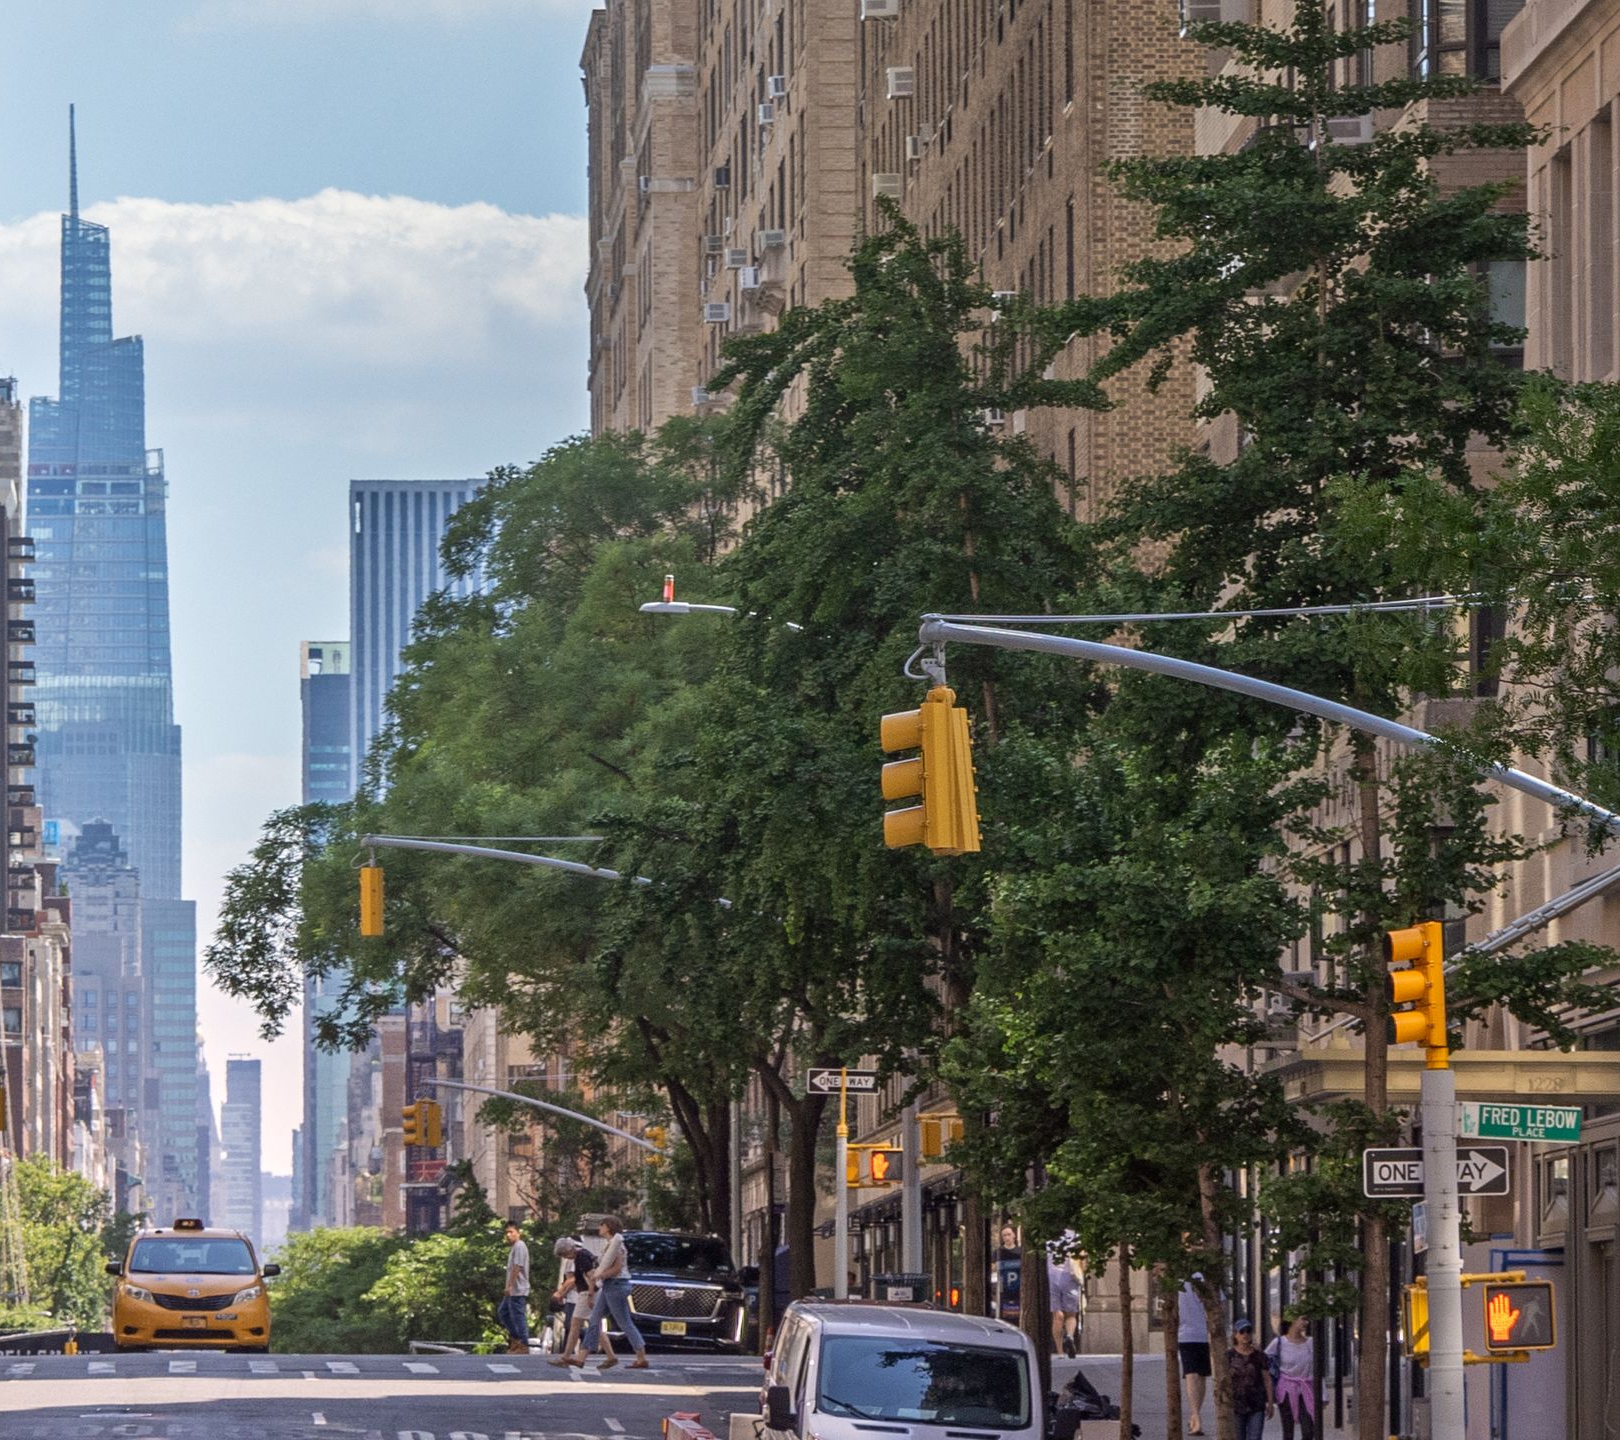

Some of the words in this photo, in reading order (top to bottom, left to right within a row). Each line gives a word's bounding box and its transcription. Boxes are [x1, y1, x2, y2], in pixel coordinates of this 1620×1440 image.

[819, 1076, 839, 1086] ONE
[849, 1078, 871, 1087] WAY
[1481, 1107, 1520, 1126] FRED
[1526, 1110, 1578, 1129] LEBOW
[1512, 1126, 1546, 1138] PLACE
[1378, 1163, 1420, 1182] ONE
[1457, 1162, 1488, 1180] AY
[1006, 1271, 1018, 1287] P
